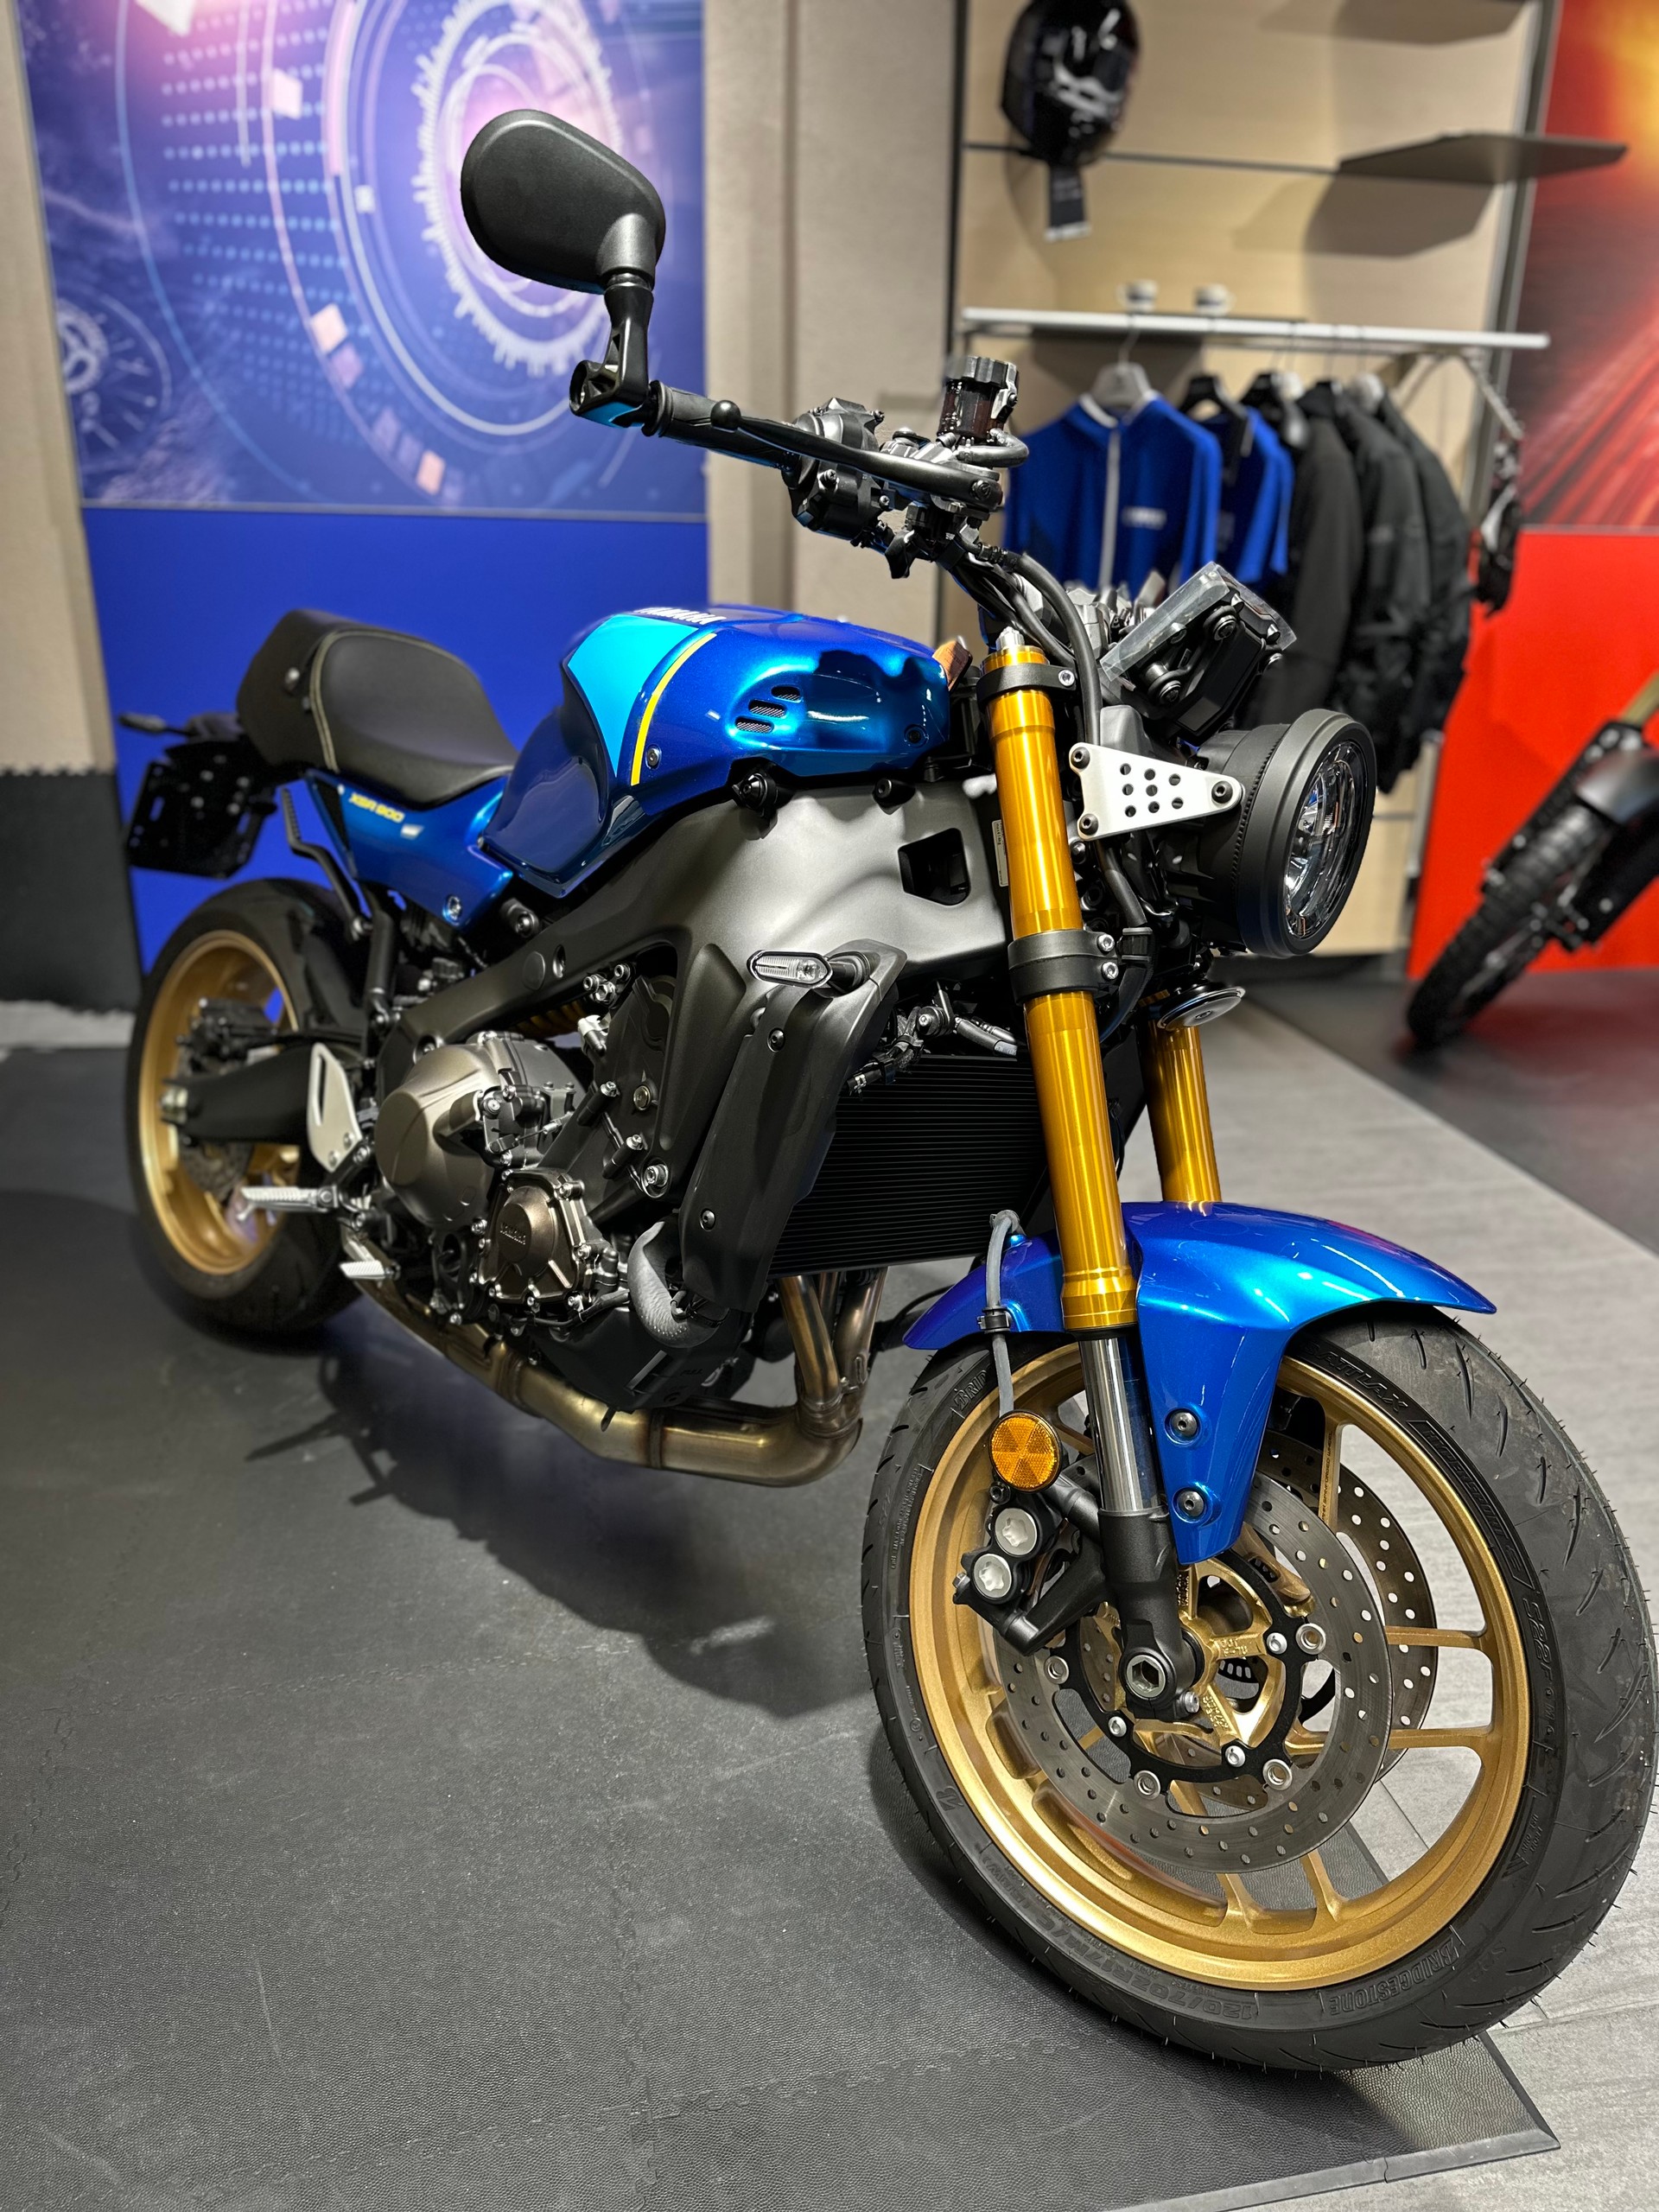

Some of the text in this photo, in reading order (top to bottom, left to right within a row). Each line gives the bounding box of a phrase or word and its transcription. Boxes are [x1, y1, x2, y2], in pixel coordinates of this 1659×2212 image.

[1303, 1339, 1408, 1414] BATTLAX
[1421, 1427, 1509, 1541] HYPERSPORT
[1327, 1941, 1460, 2016] BRIDGESTONE
